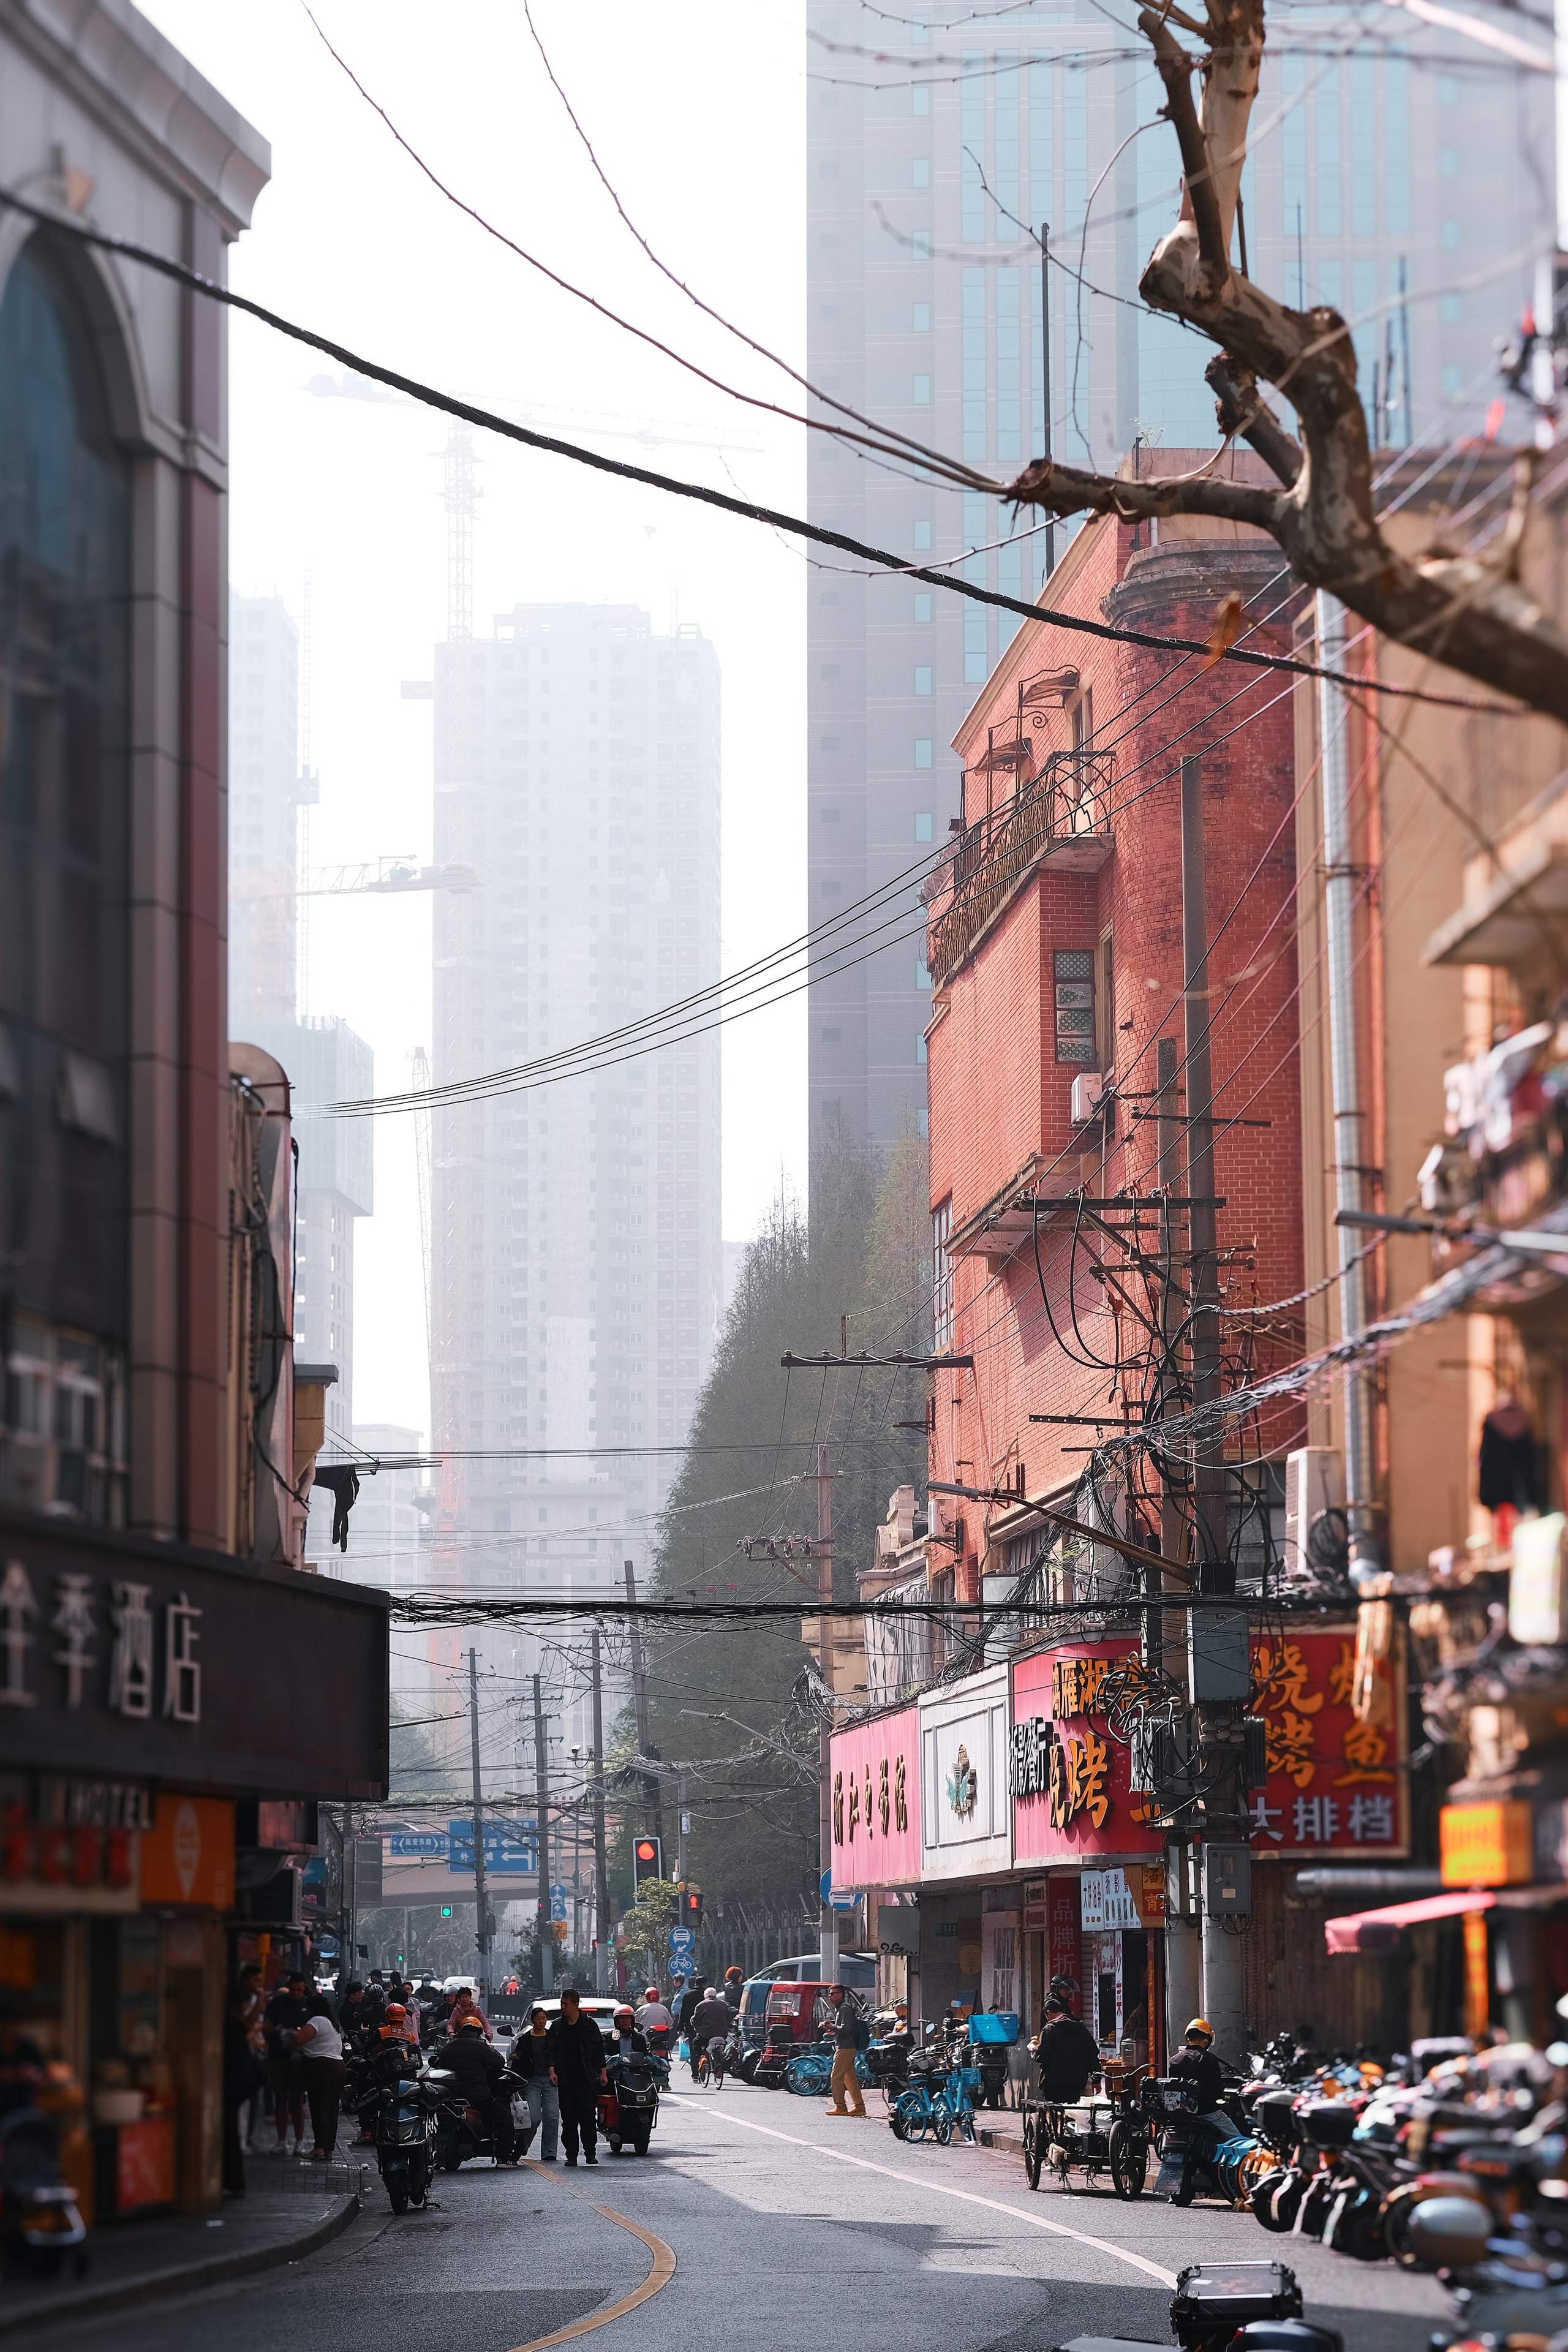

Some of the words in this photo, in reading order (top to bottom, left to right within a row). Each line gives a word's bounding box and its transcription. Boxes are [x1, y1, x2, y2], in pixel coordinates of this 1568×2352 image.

[0, 1559, 203, 1722] 全季酒店
[1008, 1717, 1046, 1796] 浙影餐厅
[454, 1838, 497, 1848] 延安道
[1248, 1794, 1394, 1842] 大排档
[1053, 1898, 1077, 2003] 品牌折
